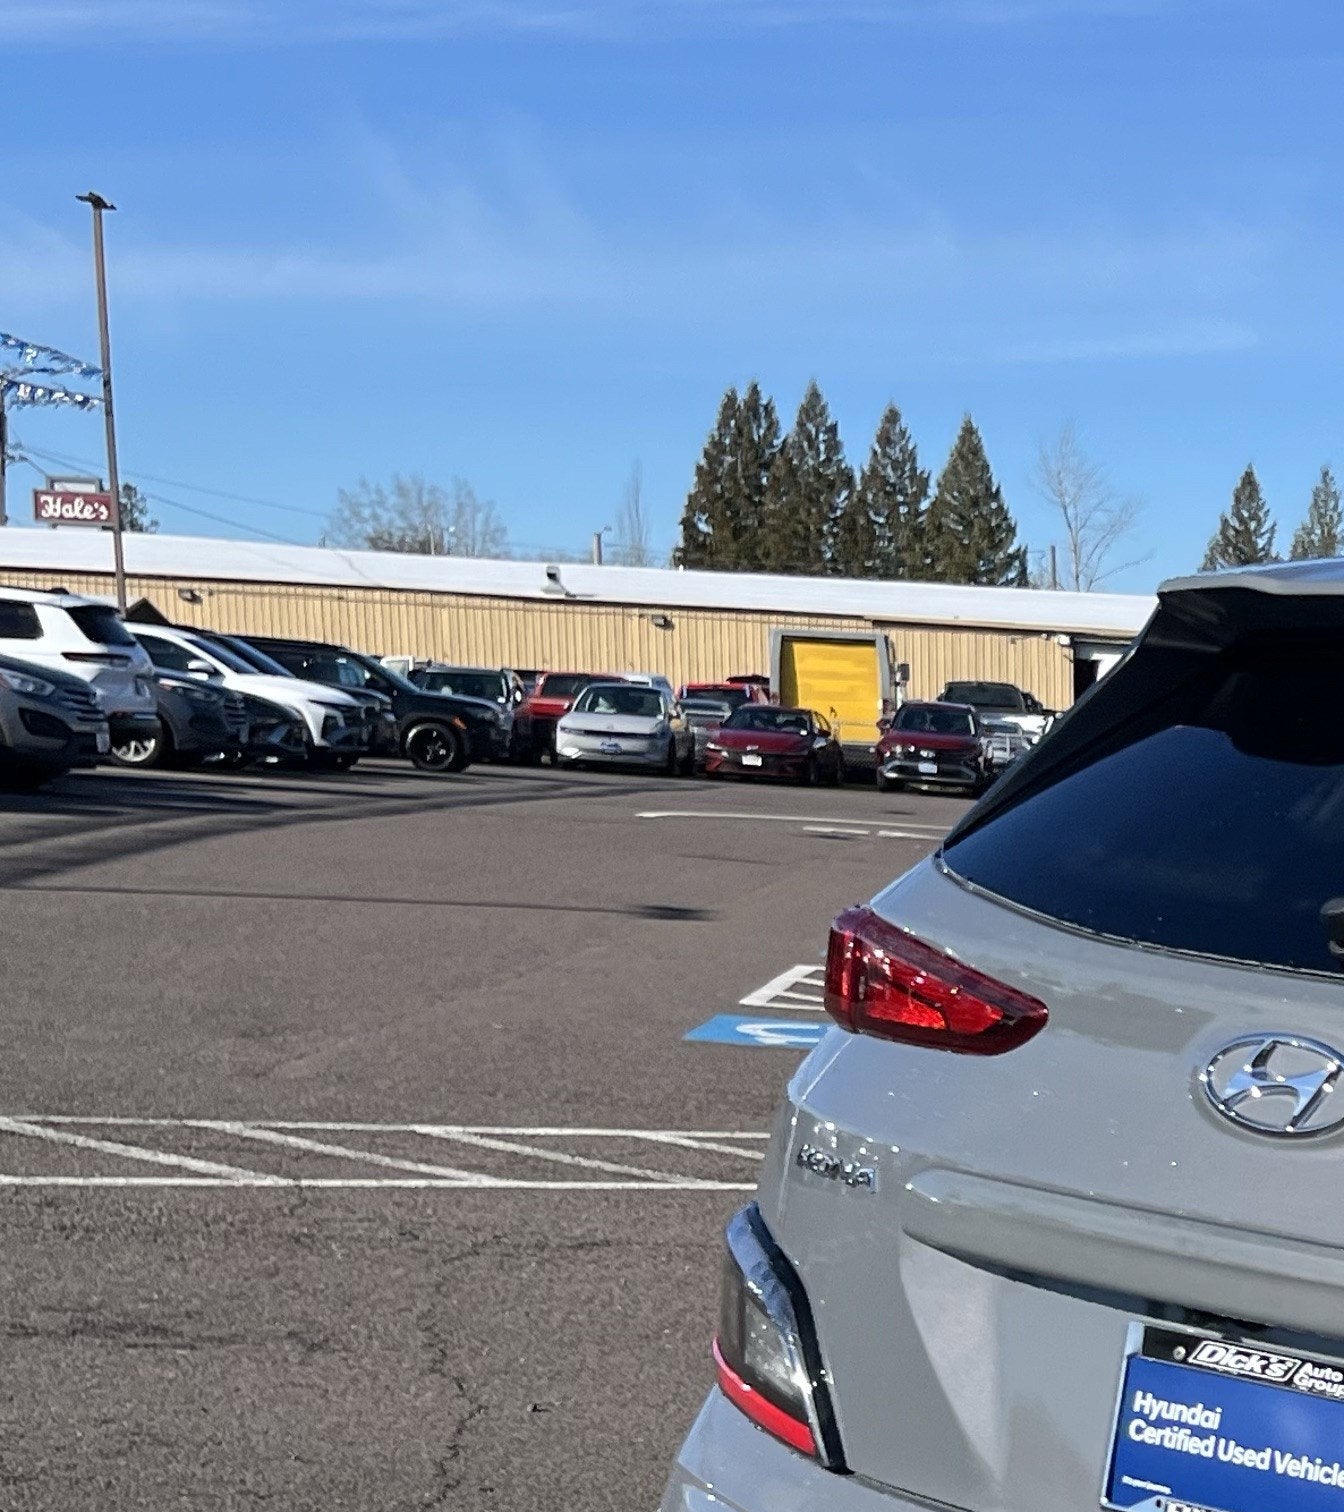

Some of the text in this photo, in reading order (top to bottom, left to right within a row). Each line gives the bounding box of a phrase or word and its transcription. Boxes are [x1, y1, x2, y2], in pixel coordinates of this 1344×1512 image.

[40, 495, 109, 520] Hale's
[1196, 1343, 1344, 1383] Dick's Auto
[1132, 1389, 1222, 1430] Hyundai
[1128, 1418, 1216, 1458] Certified
[1217, 1437, 1272, 1471] Used
